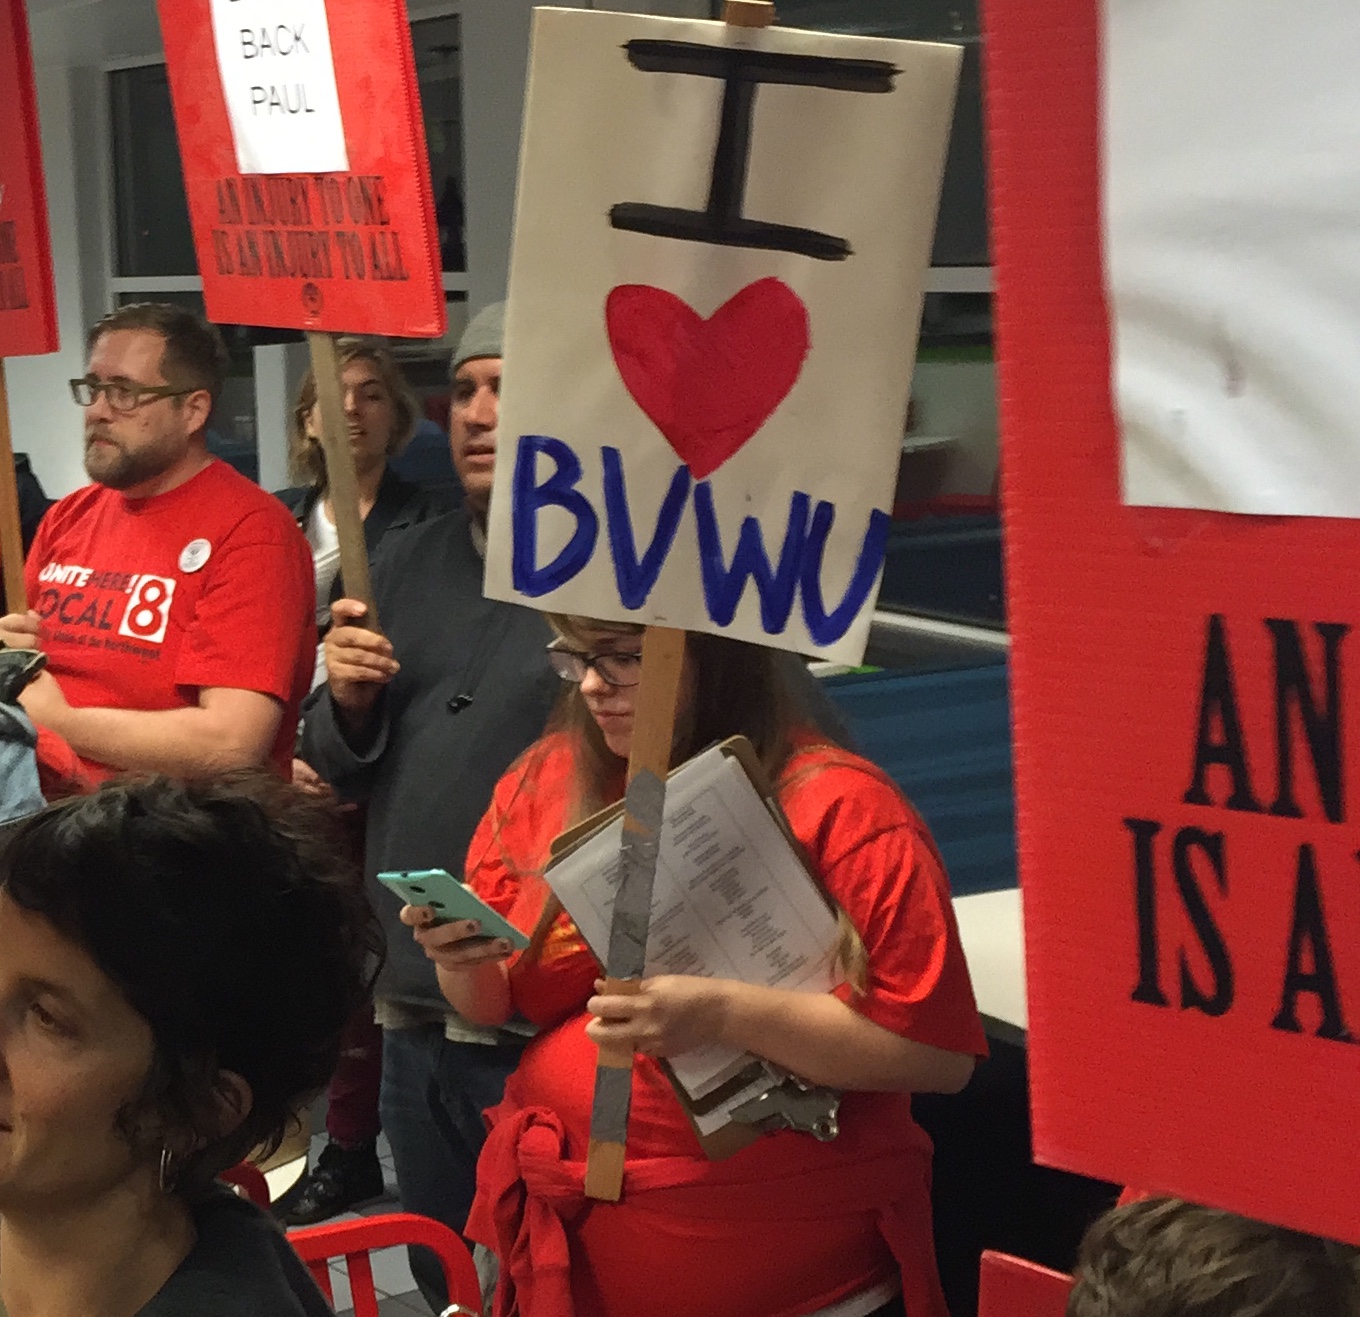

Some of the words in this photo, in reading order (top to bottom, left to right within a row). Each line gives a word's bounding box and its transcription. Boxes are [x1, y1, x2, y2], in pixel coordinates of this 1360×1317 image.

[240, 24, 309, 59] BACK
[250, 83, 315, 116] PAUL
[607, 38, 905, 261] I
[40, 588, 113, 630] OCAL
[127, 578, 167, 637] 8
[512, 435, 892, 647] BVWU
[1181, 613, 1353, 825] AN
[1122, 817, 1235, 1016] IS
[1269, 842, 1360, 1045] A
